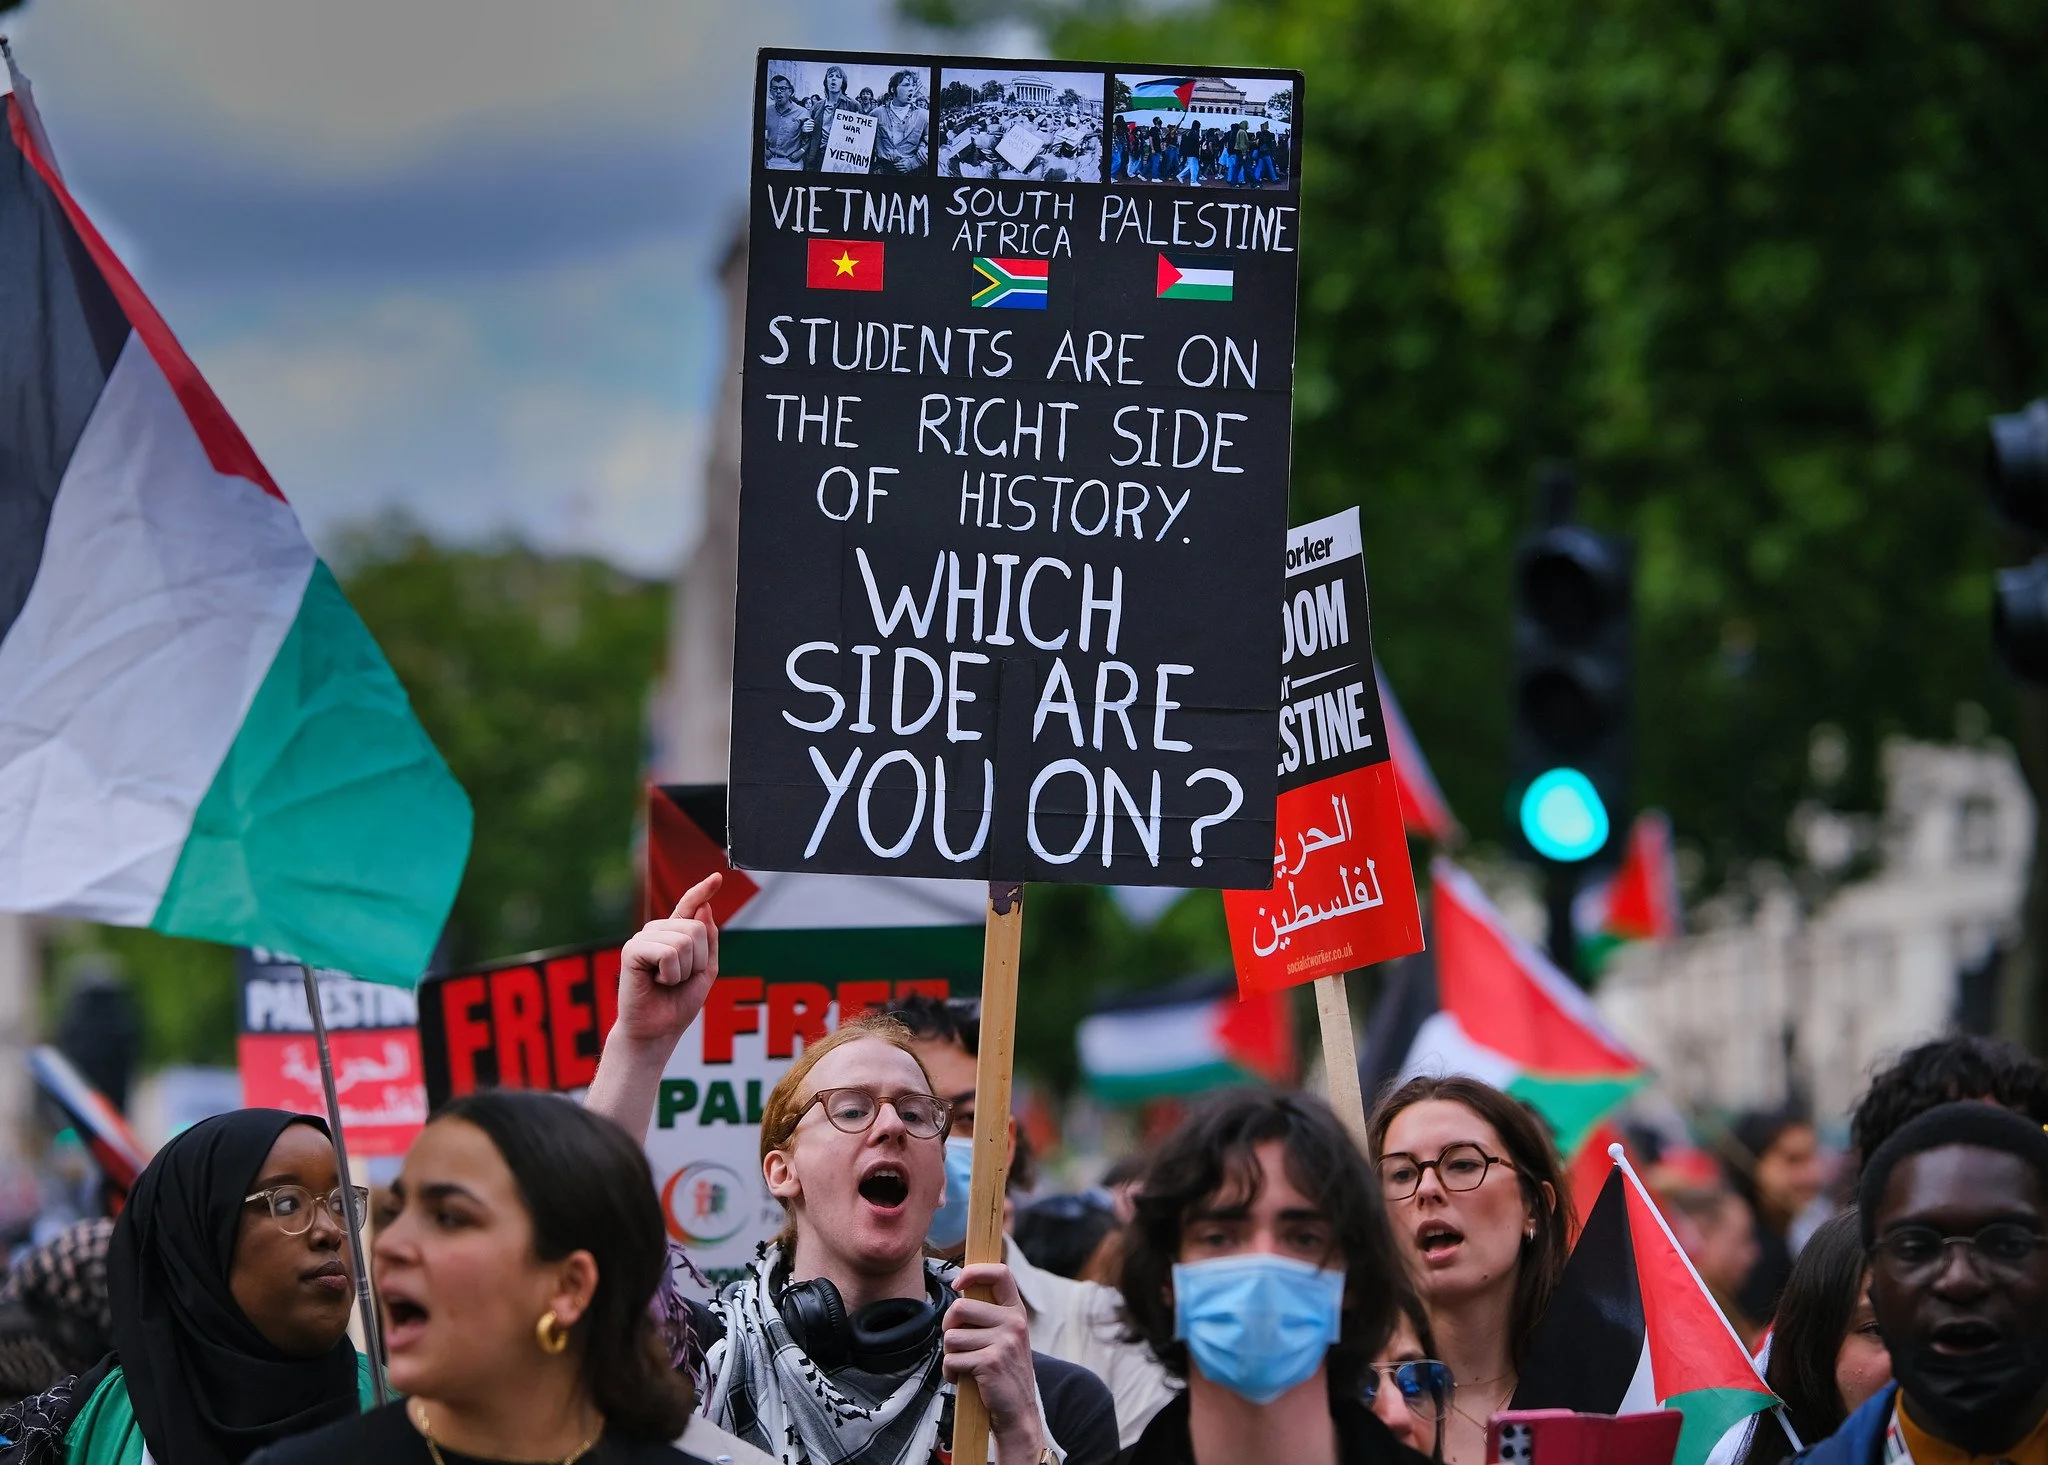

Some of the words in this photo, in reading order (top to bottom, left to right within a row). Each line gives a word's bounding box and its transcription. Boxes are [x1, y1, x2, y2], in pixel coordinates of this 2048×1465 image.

[836, 113, 854, 123] END
[857, 116, 873, 128] THE
[843, 124, 861, 135] WAR
[845, 136, 855, 144] IN
[829, 148, 870, 169] VIETNAM
[767, 184, 930, 238] VIETNAM
[945, 186, 1074, 220] SOUTH
[1099, 195, 1297, 253] PALESTINE
[951, 220, 1072, 258] AFRICA
[760, 315, 1014, 378] STUDENTS
[1046, 330, 1145, 385] ARE
[1176, 334, 1258, 389] ON
[766, 394, 861, 448] THE
[918, 393, 1079, 462] RIGHT
[1110, 405, 1249, 473] SIDE
[816, 465, 900, 523] OF
[959, 469, 1192, 545] HISTORY.
[1286, 536, 1334, 569] orker
[855, 547, 1123, 655] WHICH
[781, 641, 990, 743] SIDE
[1033, 657, 1195, 752] ARE
[1277, 681, 1372, 776] STINE
[803, 745, 993, 862] YOU
[1274, 793, 1352, 879] الحري
[1253, 857, 1384, 957] لفلسطين
[1286, 942, 1354, 975] socialistworker.co.uk
